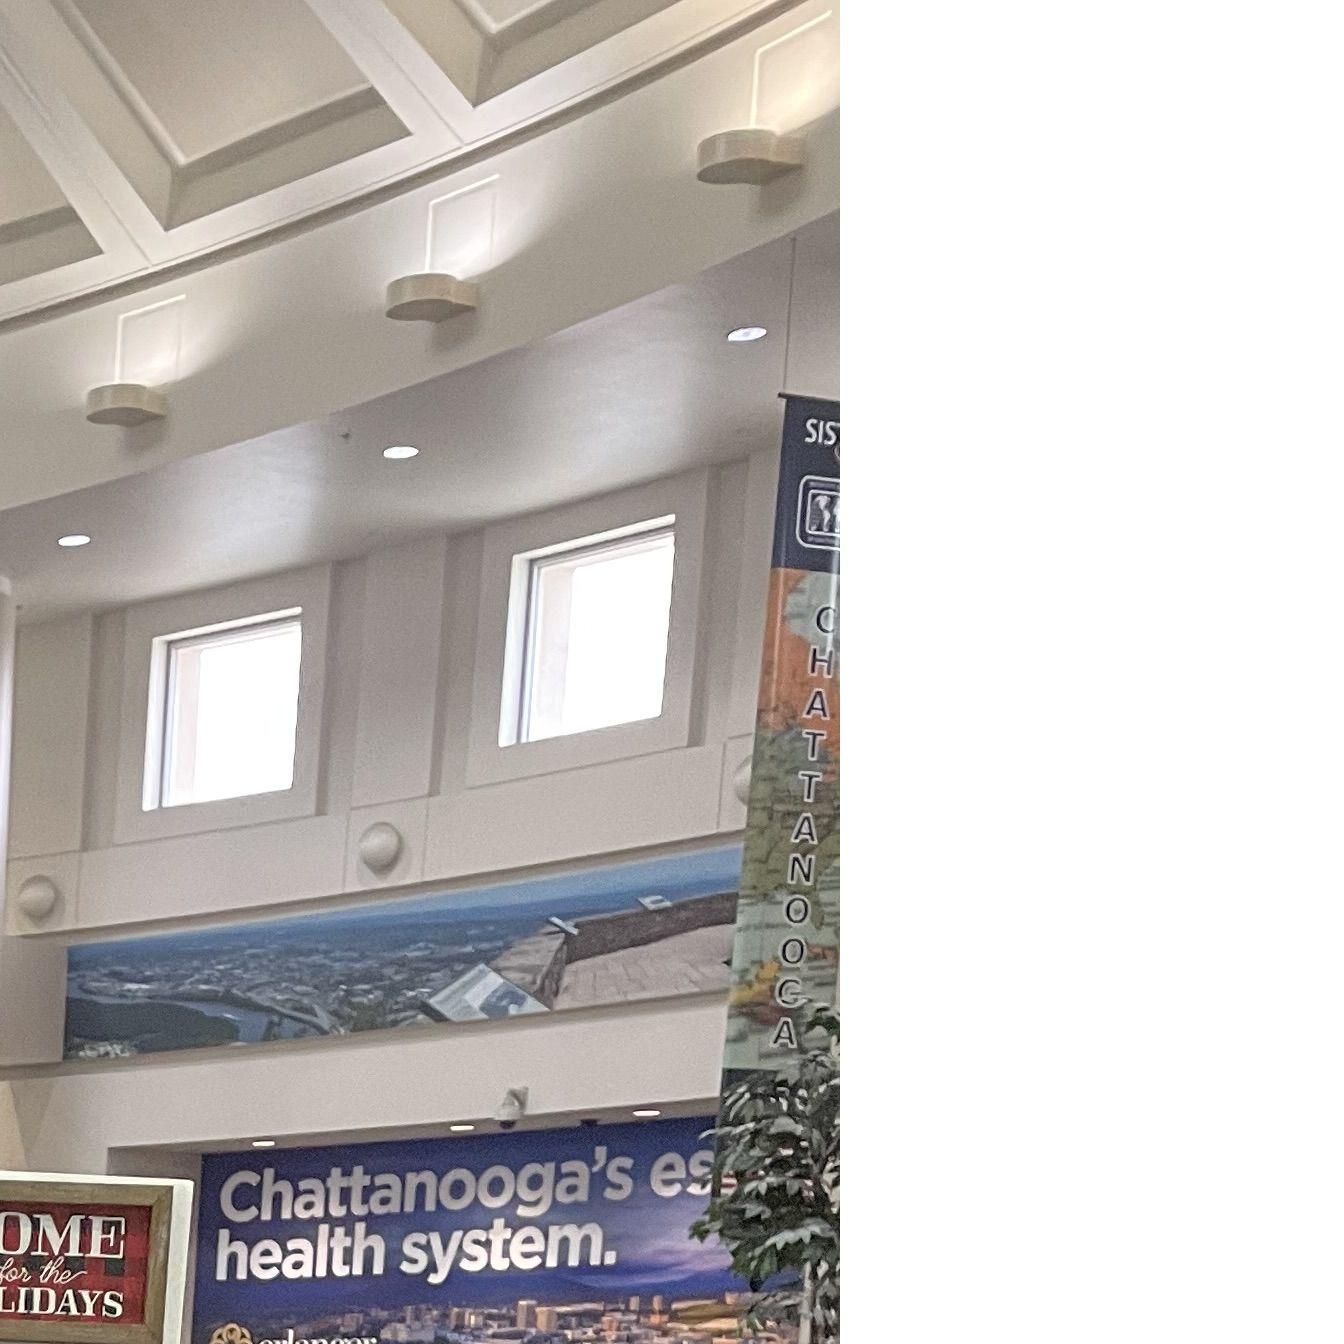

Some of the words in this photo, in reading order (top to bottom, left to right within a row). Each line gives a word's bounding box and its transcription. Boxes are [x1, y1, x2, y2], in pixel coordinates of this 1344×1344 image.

[804, 418, 840, 446] SIS
[769, 604, 837, 1049] CHATTANOOGA
[220, 1146, 633, 1223] Chattanooga's
[649, 1149, 712, 1198] es
[39, 1256, 88, 1285] the
[215, 1222, 385, 1281] health
[399, 1214, 616, 1285] system.
